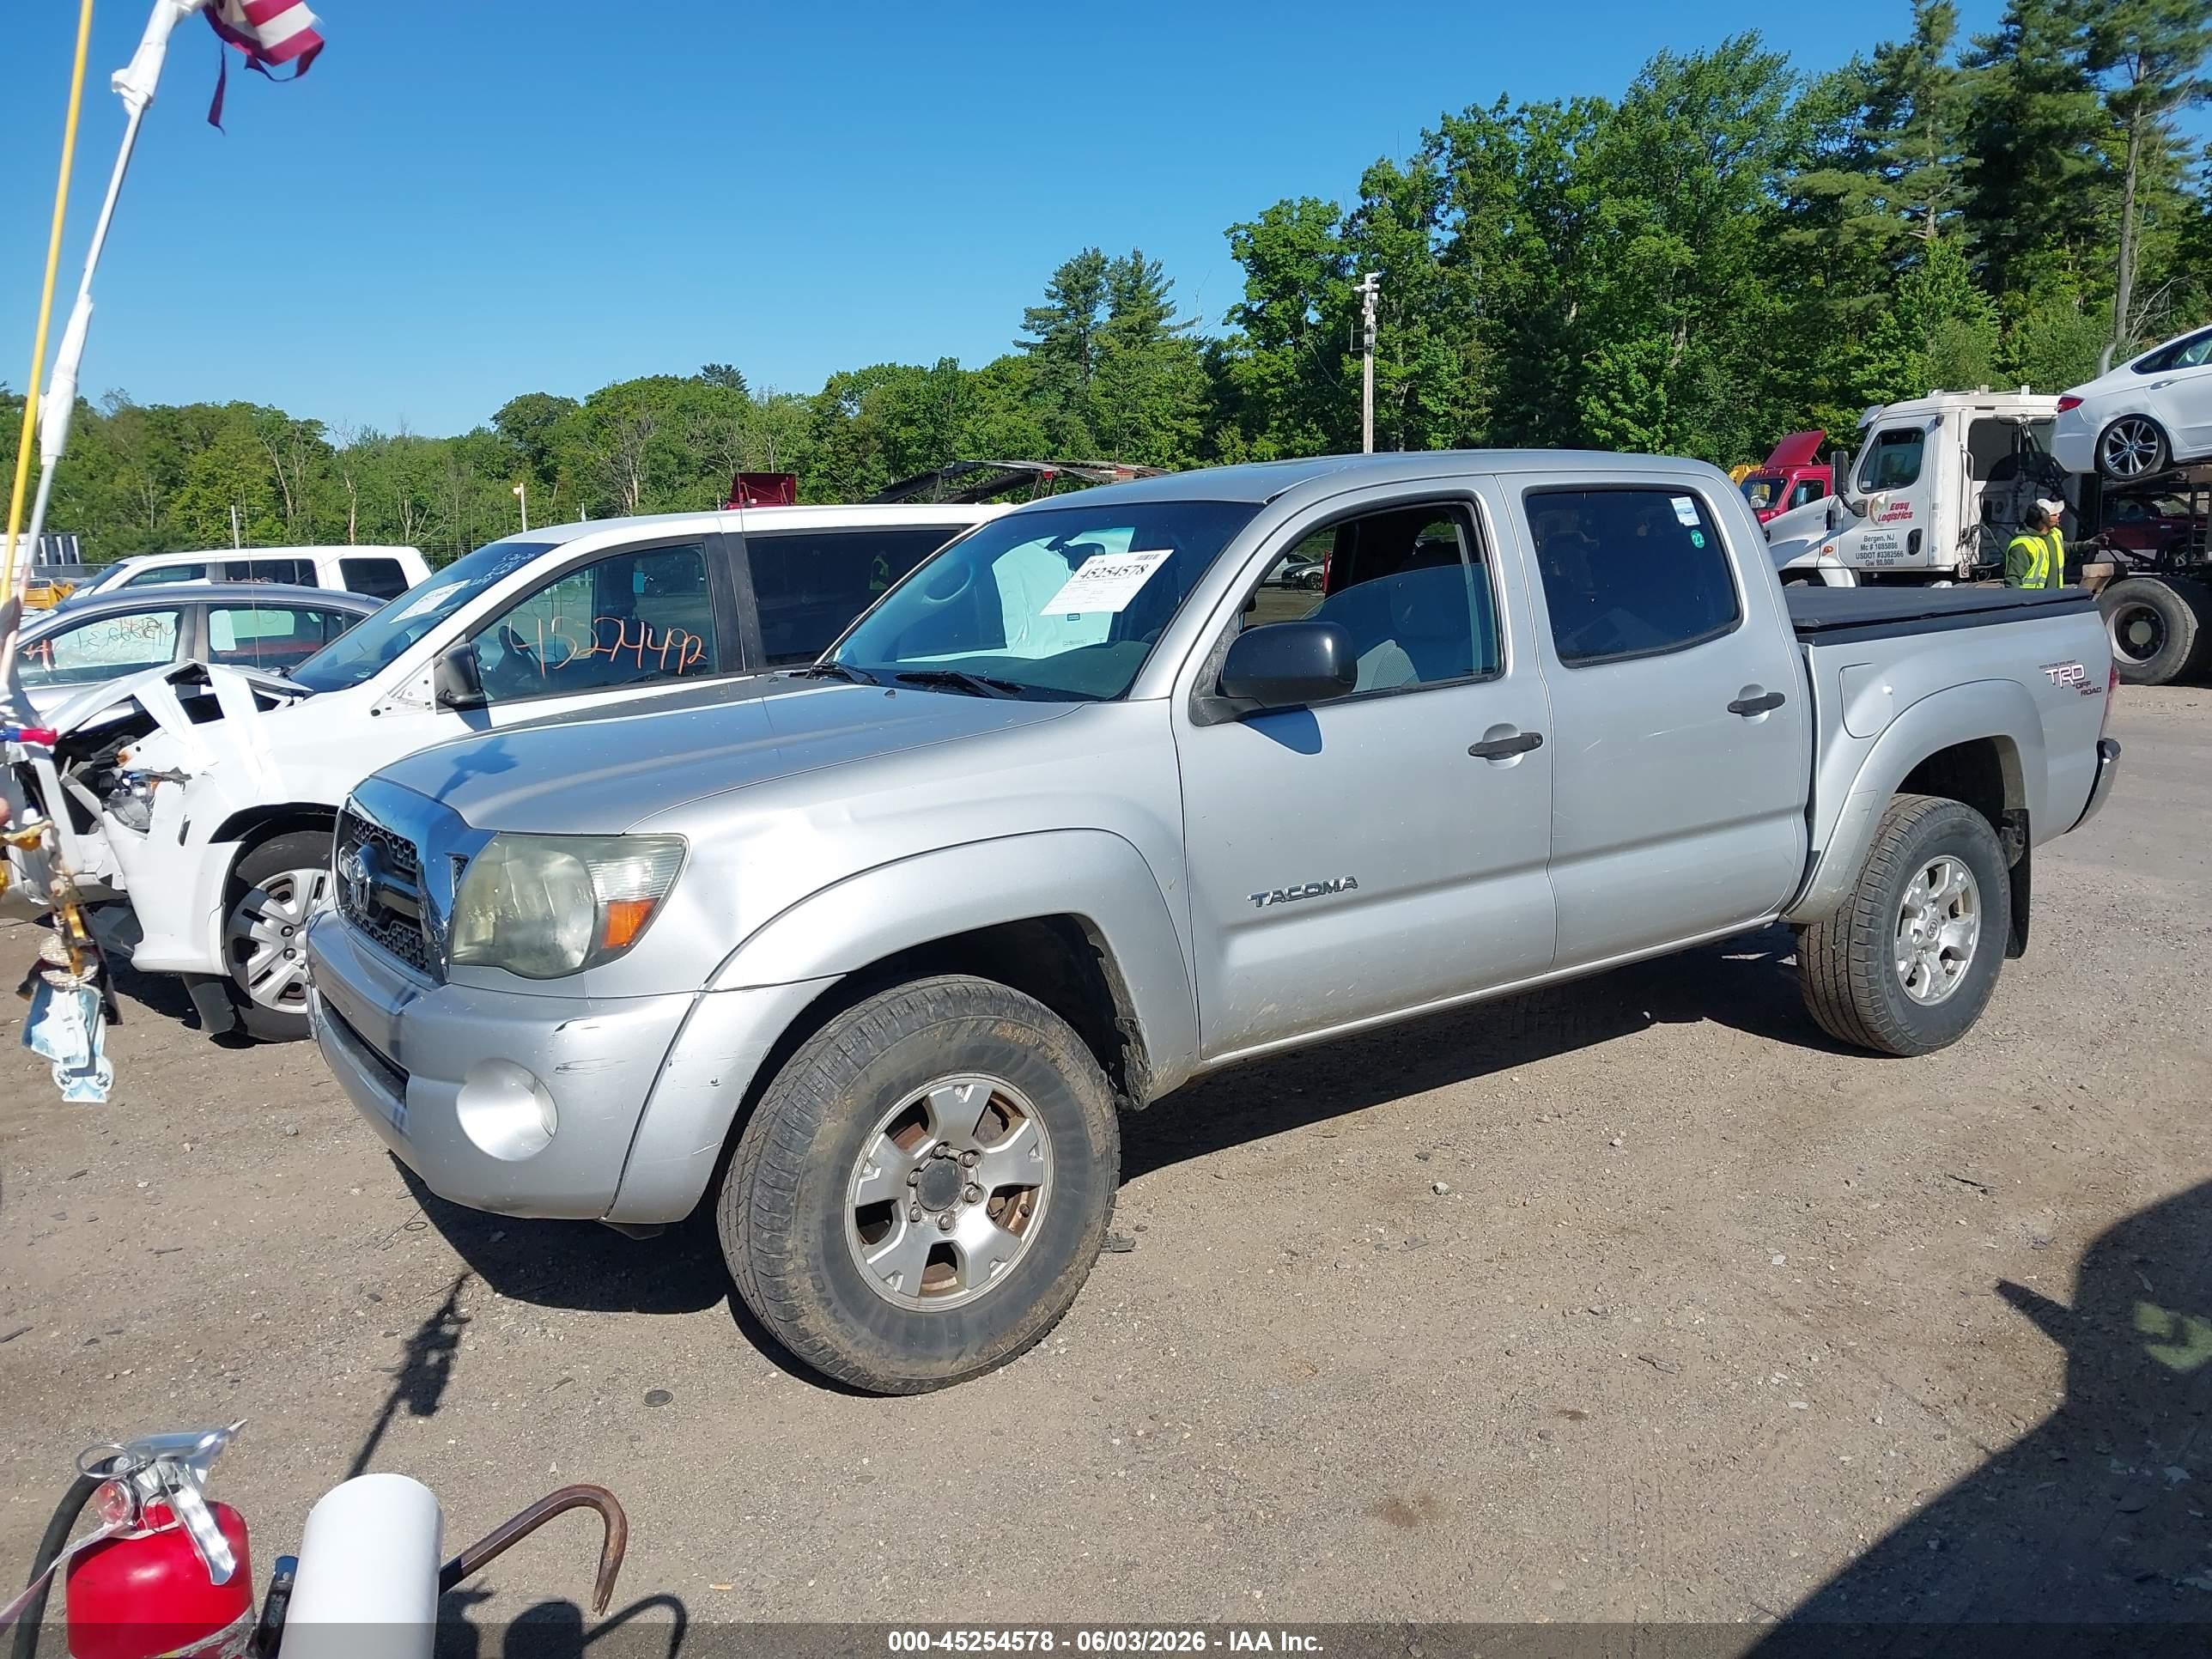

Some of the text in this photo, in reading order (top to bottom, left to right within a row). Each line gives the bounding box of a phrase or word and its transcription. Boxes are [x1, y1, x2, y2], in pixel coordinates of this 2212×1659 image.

[1889, 501, 1910, 511] Easy
[1877, 512, 1913, 522] Logistics
[1863, 535, 1886, 544] Bergen,
[1855, 551, 1875, 560] USDOT
[1079, 563, 1149, 580] 45254578
[2045, 664, 2085, 689] TRD
[2075, 680, 2092, 690] OFF
[2081, 686, 2102, 696] ROAD
[1247, 874, 1358, 908] TACOMA
